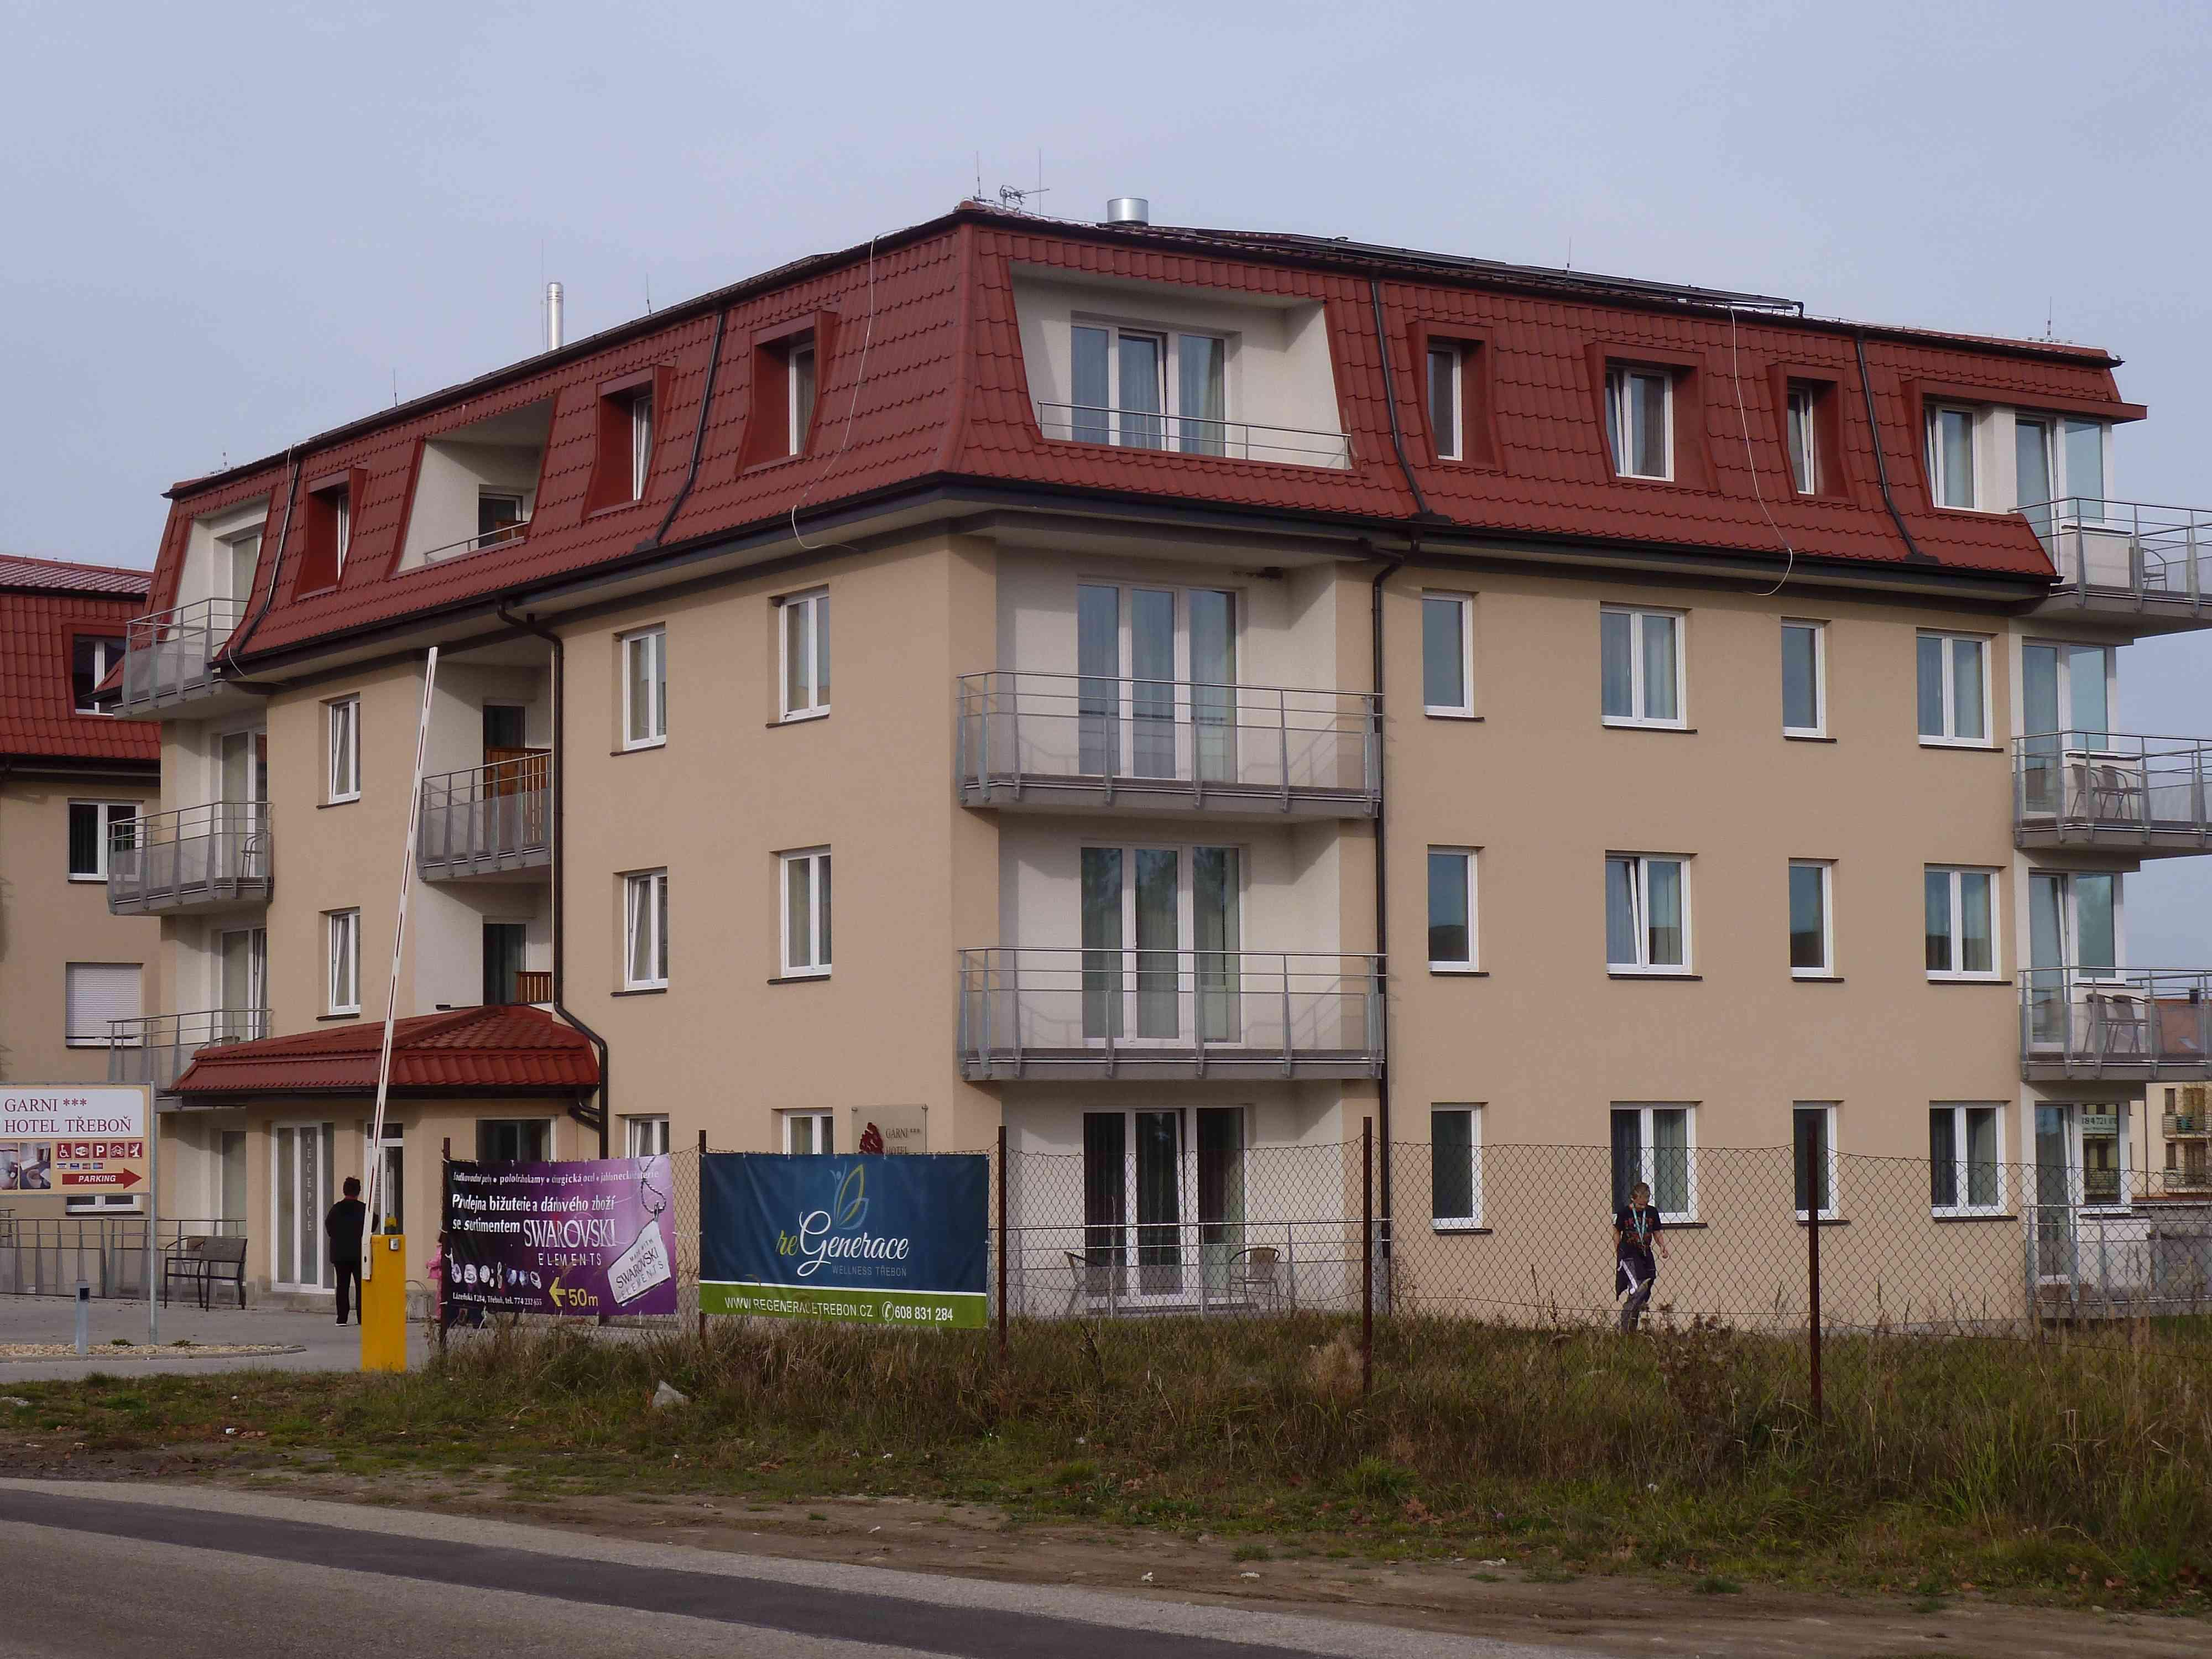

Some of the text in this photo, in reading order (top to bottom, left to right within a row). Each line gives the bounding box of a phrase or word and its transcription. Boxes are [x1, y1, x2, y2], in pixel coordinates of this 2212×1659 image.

[4, 1098, 58, 1112] GARNI
[4, 1115, 132, 1133] HOTEL TŘEBOŇ
[885, 1128, 908, 1139] GARNI
[96, 1145, 105, 1156] P
[79, 1175, 116, 1183] PARKING
[489, 1195, 531, 1212] bižuterie
[533, 1201, 538, 1212] a
[592, 1194, 616, 1211] zboží
[452, 1218, 461, 1230] se
[523, 1218, 617, 1248] SWAROVSKI
[775, 1210, 909, 1277] reGenerace
[538, 1253, 602, 1266] ELEMENTS
[615, 1246, 659, 1288] SWAROVSKI
[832, 1265, 872, 1275] WELLNESS
[894, 1308, 912, 1319] 608
[914, 1308, 932, 1321] 831
[935, 1308, 953, 1322] 284
